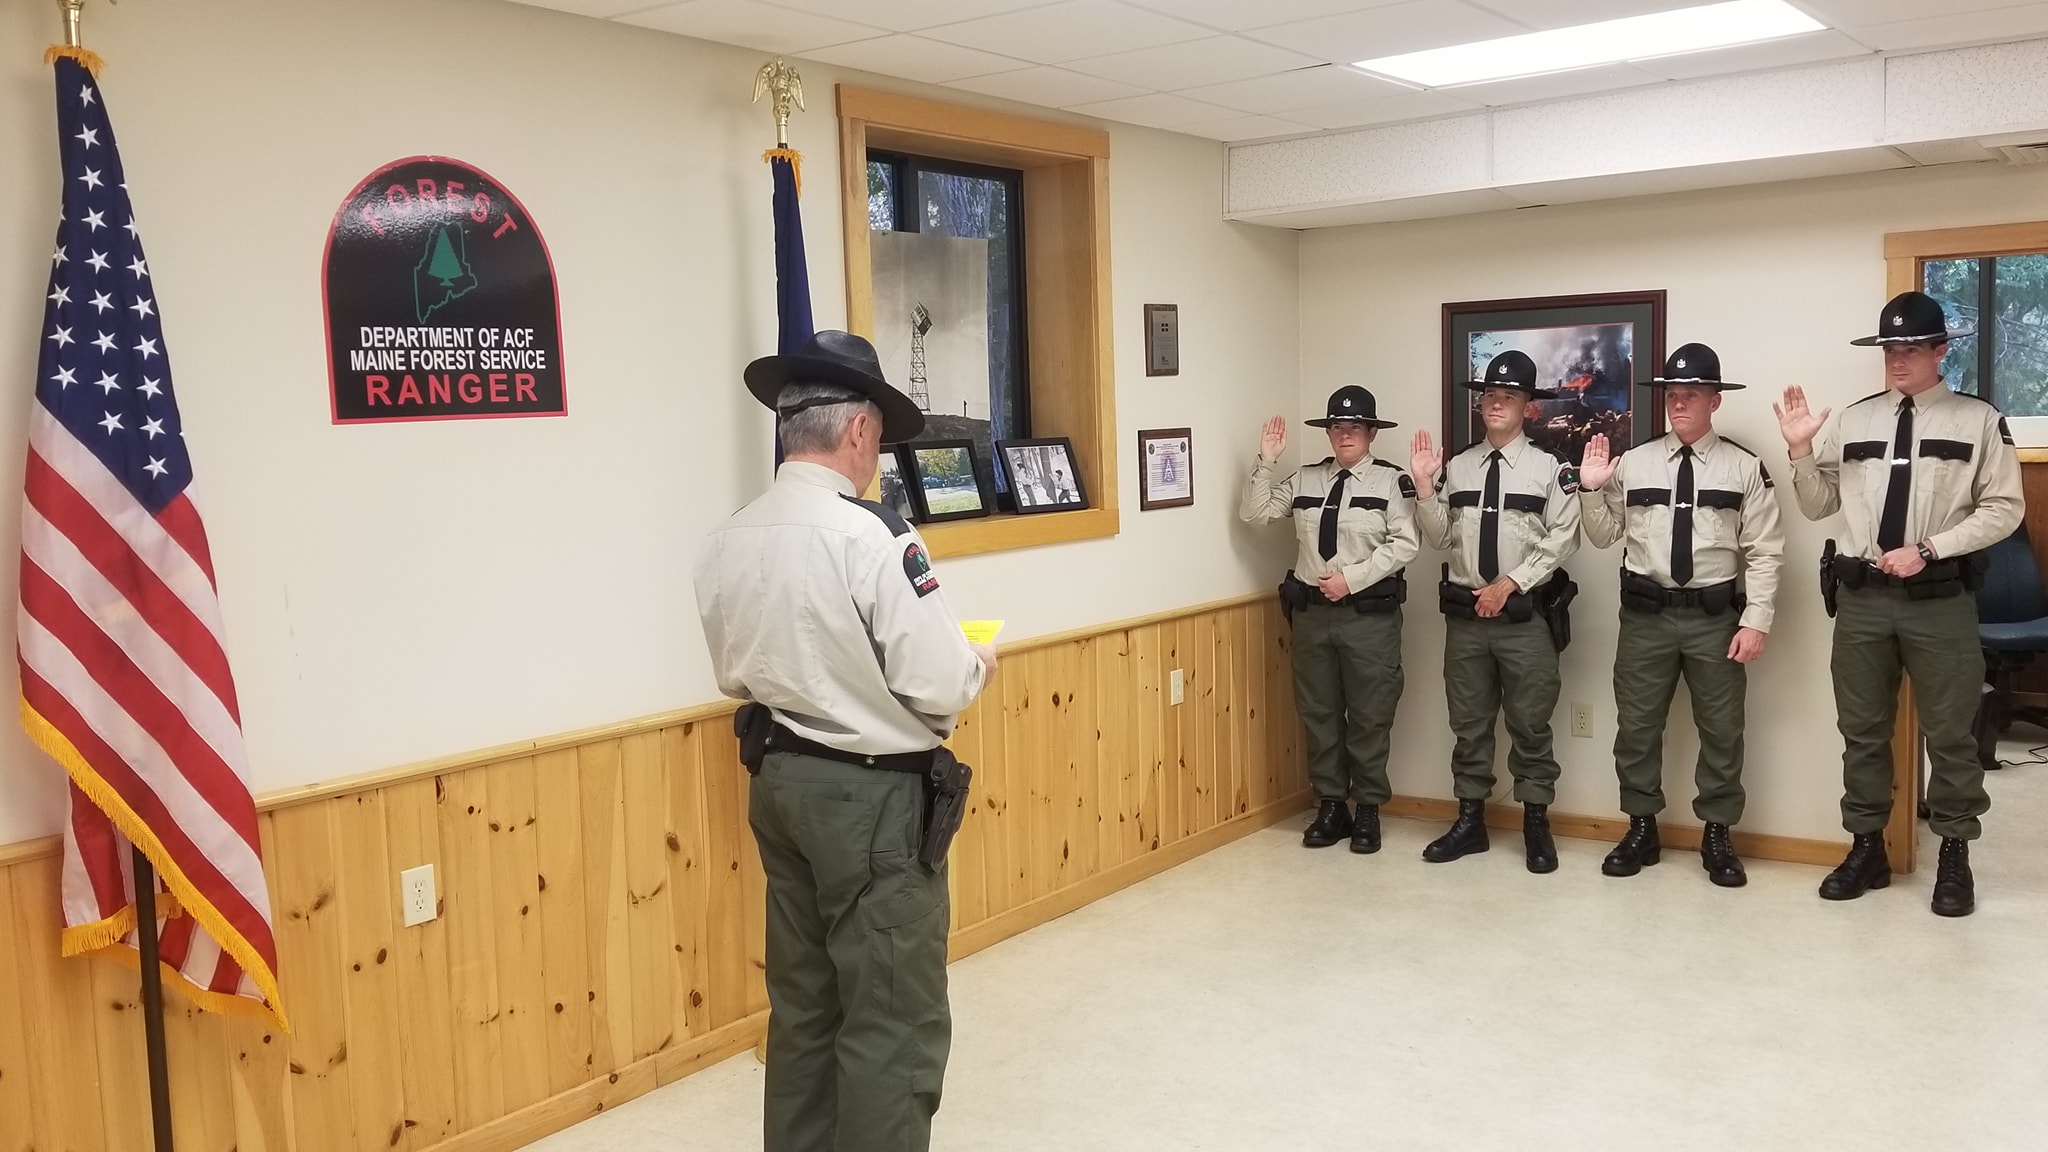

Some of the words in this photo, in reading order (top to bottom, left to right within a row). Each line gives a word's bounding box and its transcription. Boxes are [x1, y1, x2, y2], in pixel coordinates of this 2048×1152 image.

[360, 178, 518, 239] FOREST
[360, 326, 474, 348] DEPARTMENT
[478, 327, 500, 348] OF
[503, 328, 534, 348] ACF
[350, 350, 406, 371] MAINE
[410, 350, 475, 371] FOREST
[480, 350, 546, 370] SERVICE
[366, 373, 538, 406] RANGER
